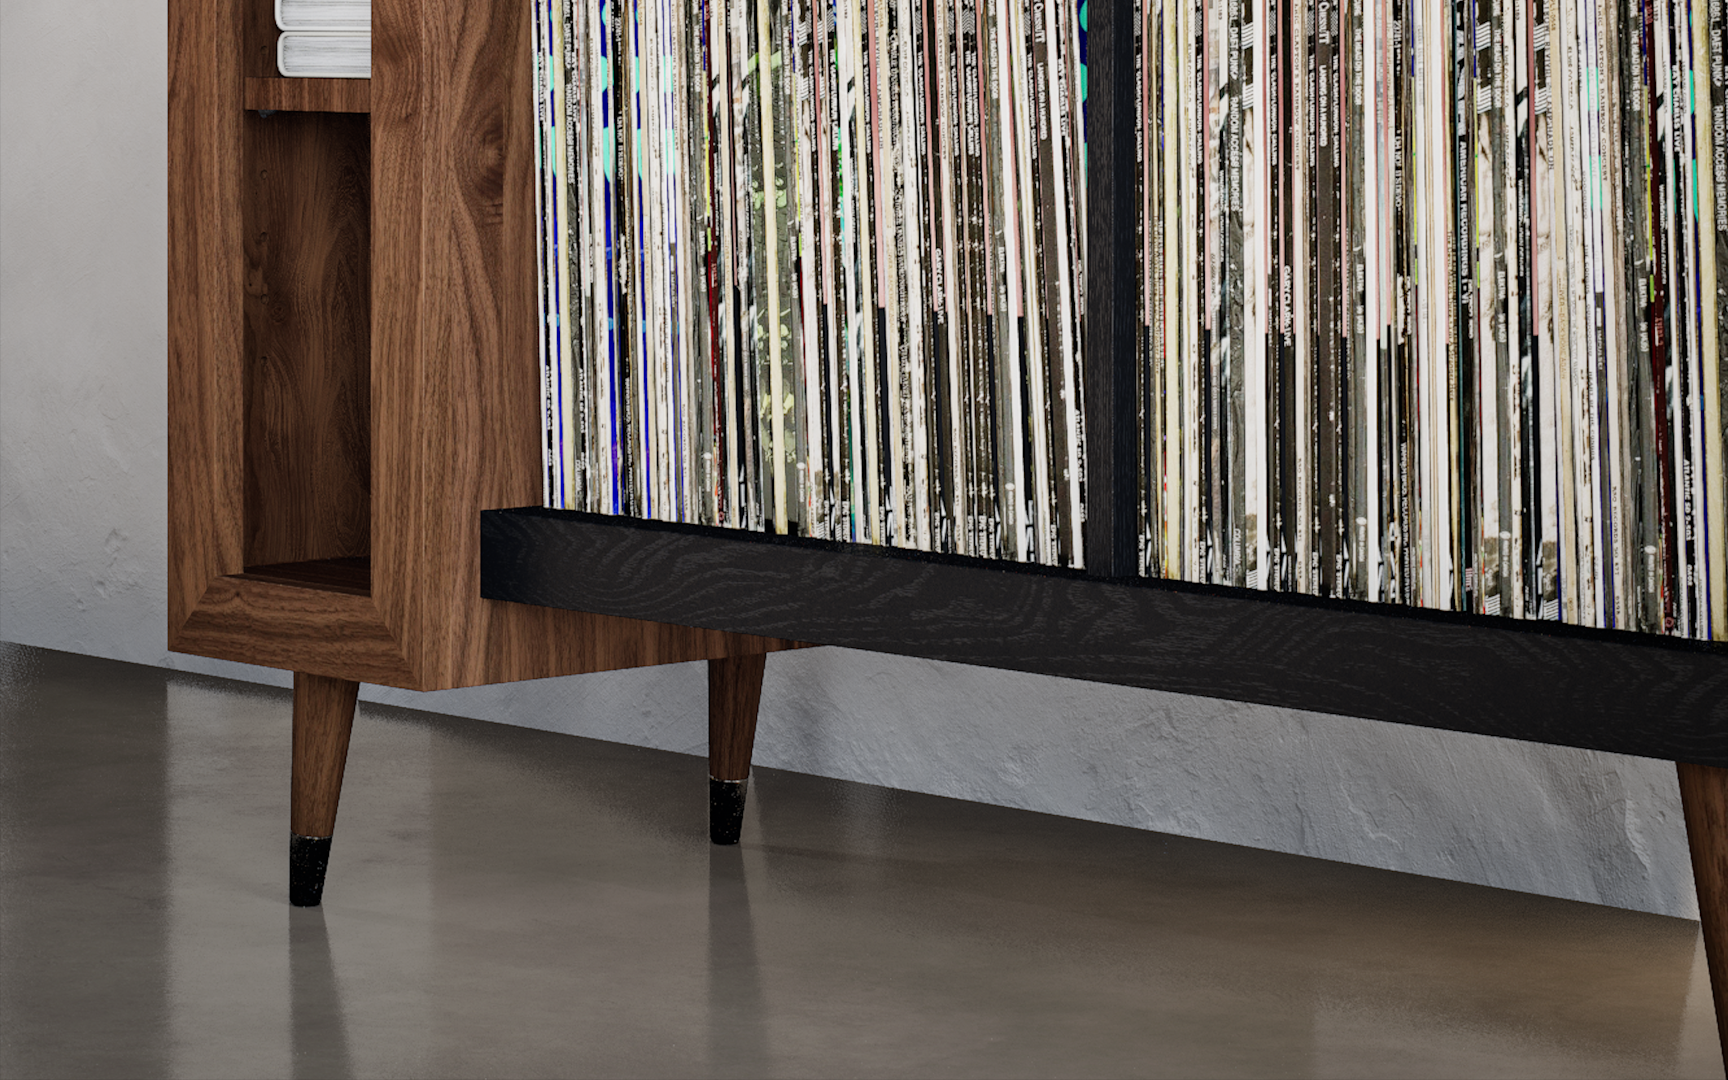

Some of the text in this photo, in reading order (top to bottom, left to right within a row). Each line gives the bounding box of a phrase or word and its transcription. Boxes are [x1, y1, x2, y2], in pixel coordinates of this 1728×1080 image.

[1230, 27, 1238, 50] DAFT
[1711, 30, 1721, 53] DAFT
[1231, 97, 1239, 130] RANDOM
[1714, 106, 1724, 143] RANDOM
[1231, 134, 1239, 166] ACCESS
[1715, 146, 1726, 184] ACCESS
[1231, 168, 1239, 211] MEMORIES
[1459, 142, 1467, 202] AMERICAN
[1717, 184, 1728, 231] MEMORIES
[1460, 204, 1468, 276] RECORDINGS
